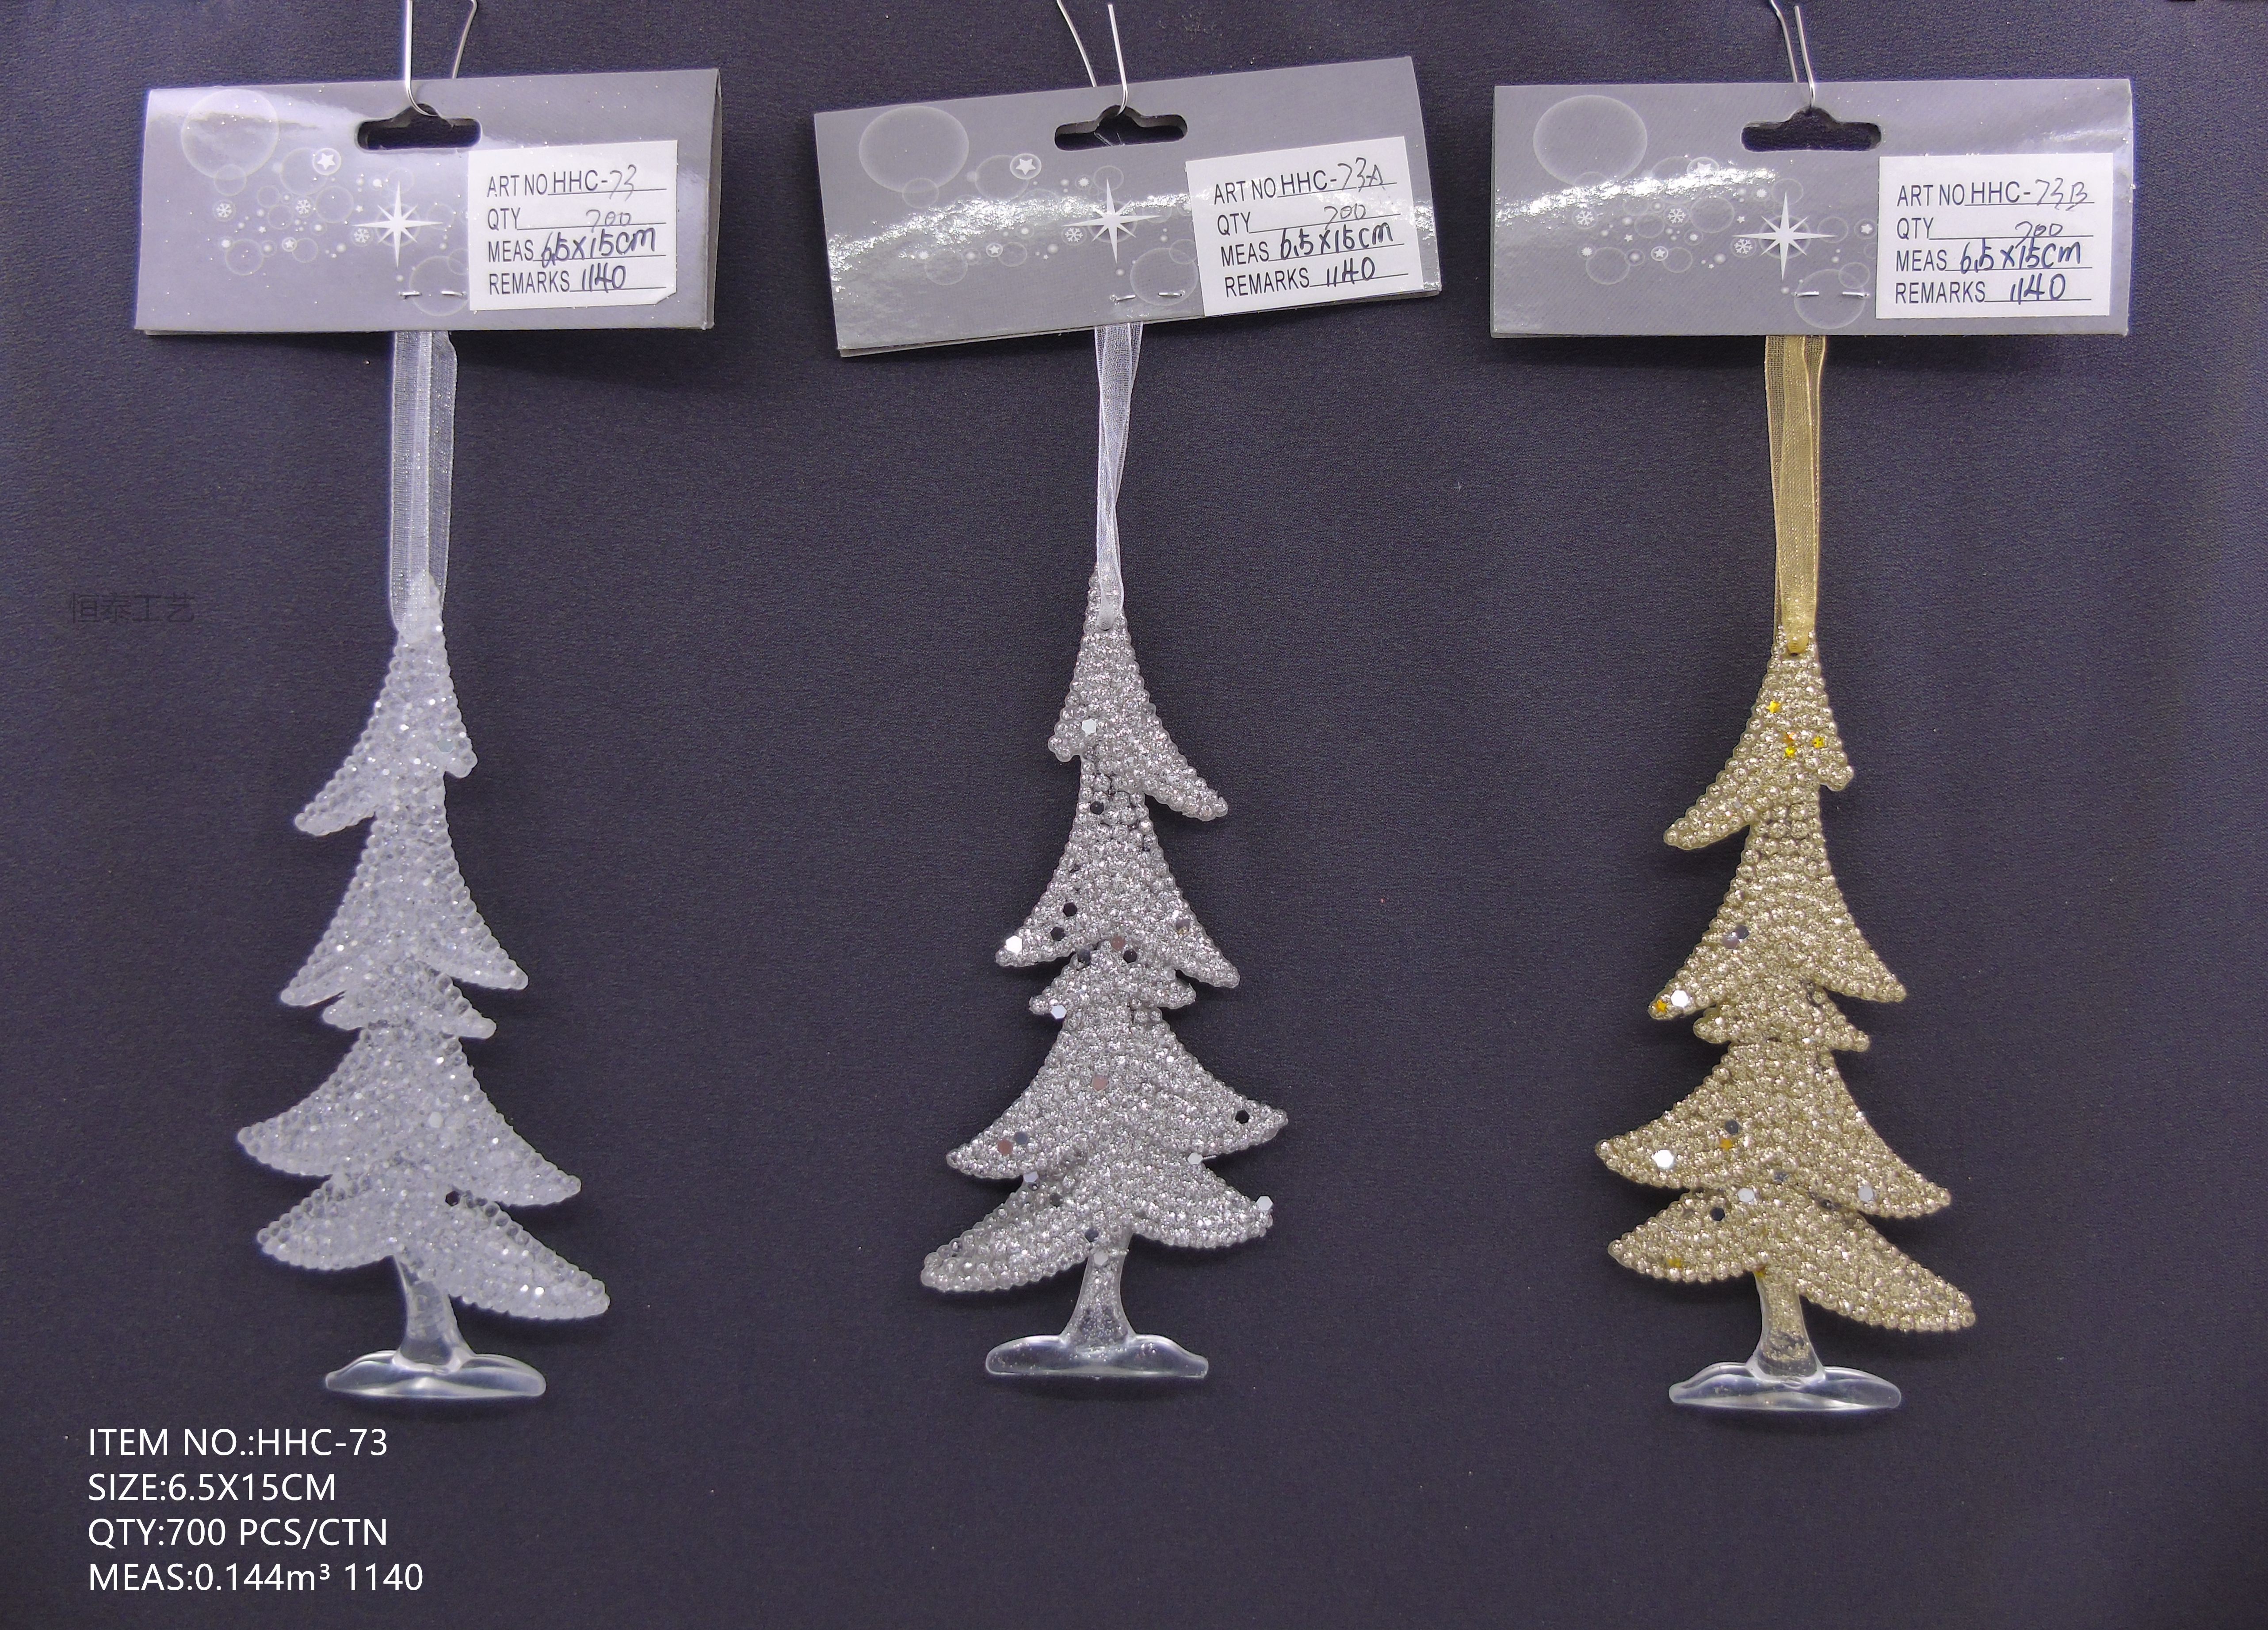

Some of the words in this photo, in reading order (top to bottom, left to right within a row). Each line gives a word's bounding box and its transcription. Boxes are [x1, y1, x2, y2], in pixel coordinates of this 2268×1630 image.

[487, 175, 519, 197] ART
[525, 173, 548, 195] NO
[554, 164, 637, 201] HHC-73
[1214, 180, 1246, 205] ART
[1252, 177, 1276, 201] NO
[1280, 157, 1386, 195] HHC-73A
[1897, 184, 1933, 207] ART
[1939, 184, 1965, 206] NO
[1971, 177, 2088, 211] HHC-73B
[488, 207, 521, 231] QTY
[586, 209, 632, 233] 700
[1218, 211, 1251, 236] QTY
[1324, 203, 1366, 230] 700
[1897, 217, 1933, 240] QTY
[2015, 221, 2063, 248] 700
[488, 240, 534, 262] MEAS
[1221, 241, 1269, 267] MEAS
[1896, 250, 1947, 272] MEAS
[489, 270, 570, 295] REMARKS
[582, 263, 626, 294] 1140
[1225, 267, 1309, 298] REMARKS
[1327, 257, 1375, 287] 1140
[1895, 281, 1985, 304] REMARKS
[2010, 273, 2066, 305] 1140
